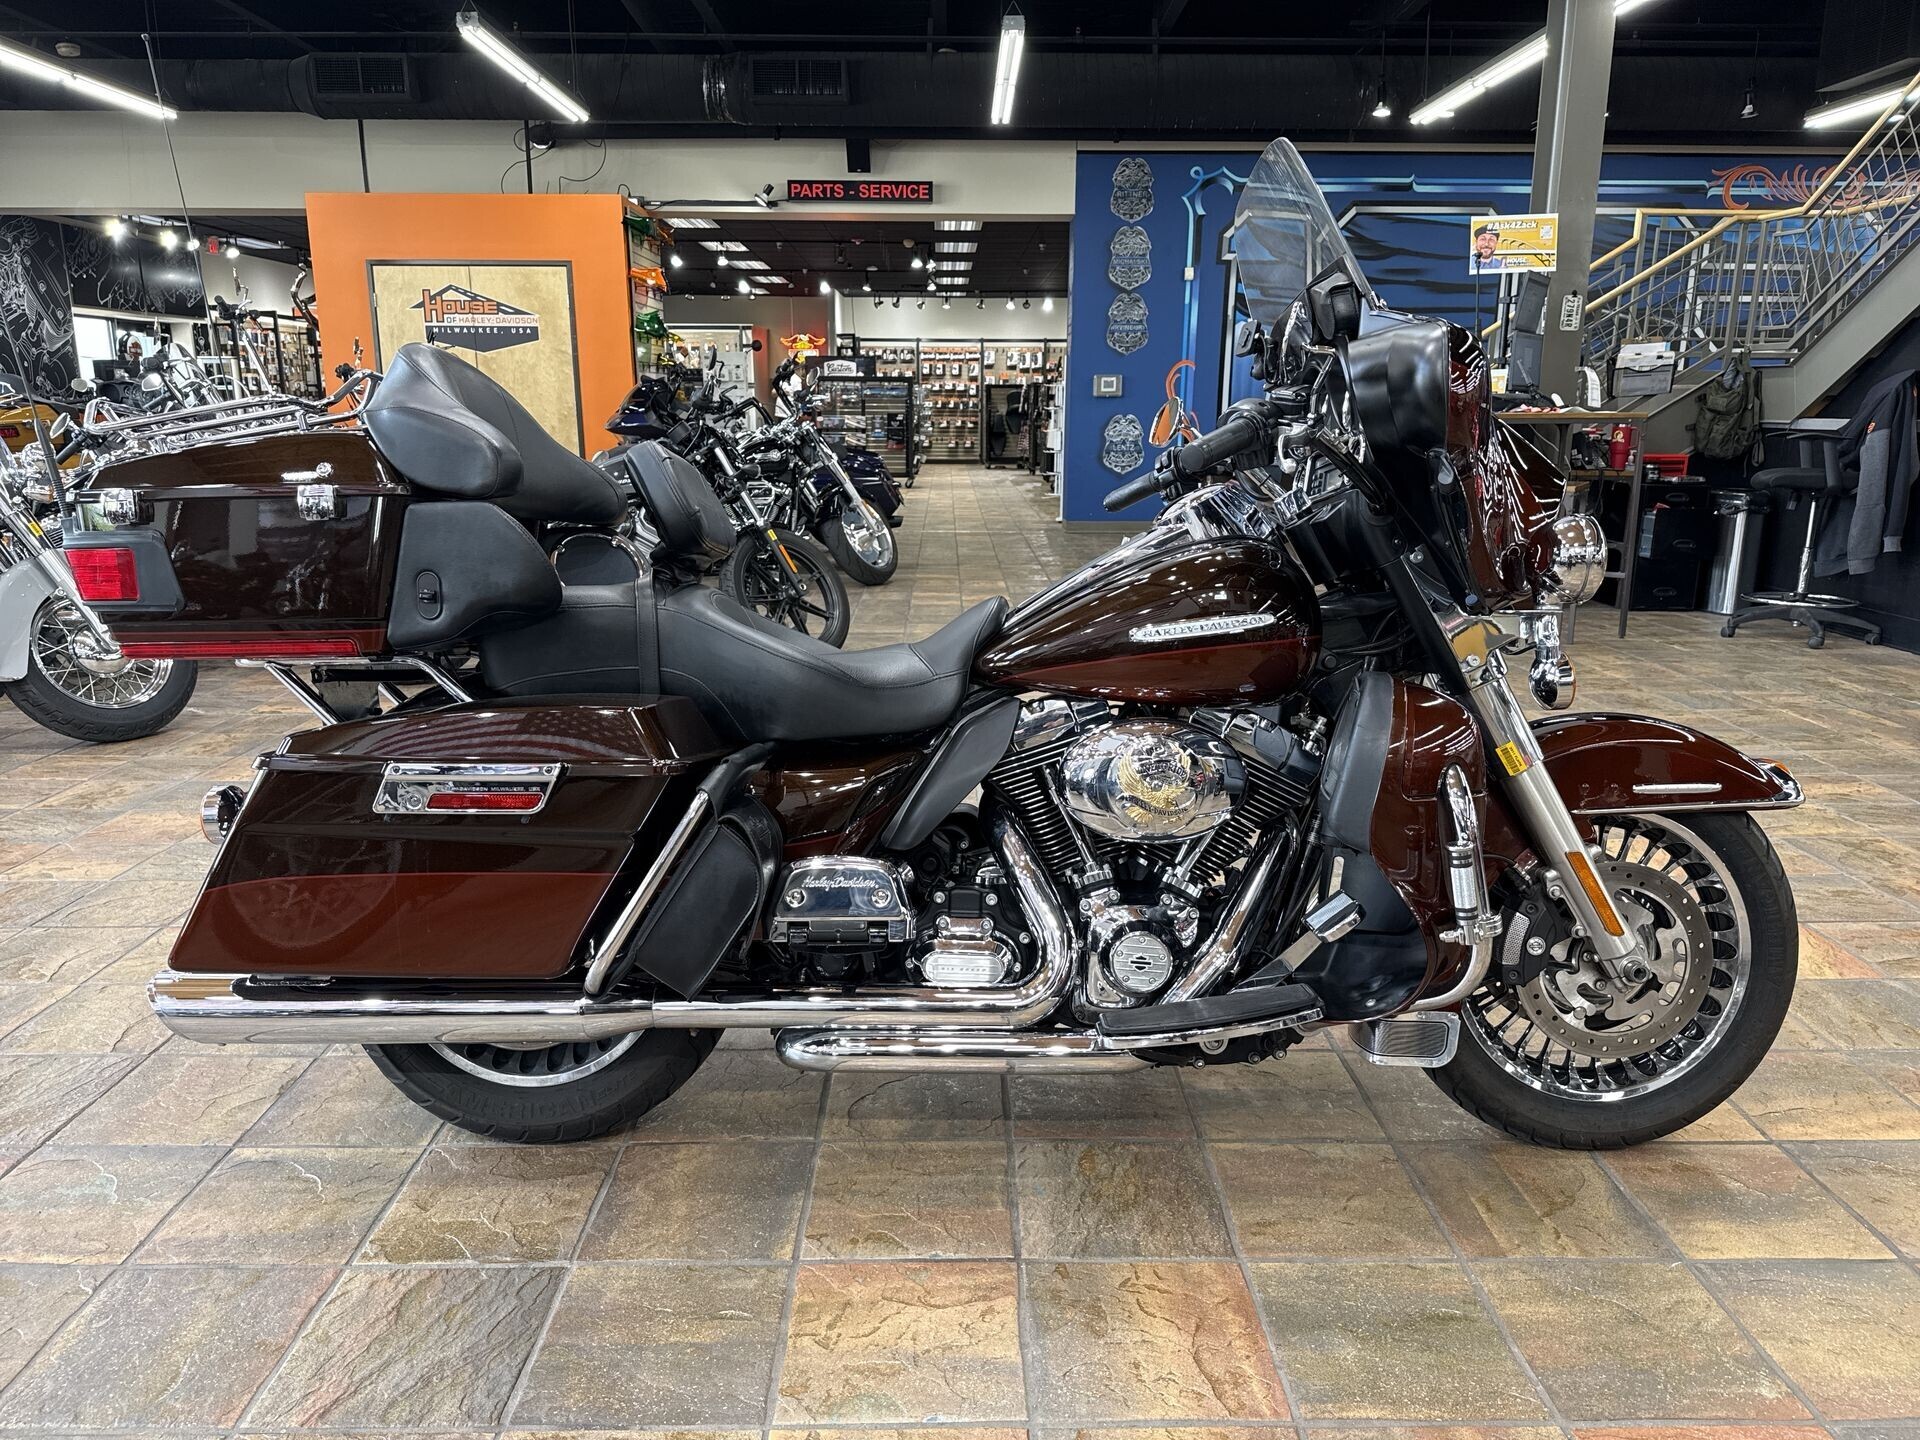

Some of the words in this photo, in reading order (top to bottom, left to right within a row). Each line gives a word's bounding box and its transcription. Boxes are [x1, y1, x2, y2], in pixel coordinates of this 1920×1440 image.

[791, 183, 844, 198] PARTS
[859, 184, 929, 199] SERVICE
[1487, 221, 1537, 230] #Ask4Zack
[422, 289, 499, 323] HOUSE
[446, 316, 457, 324] OF
[459, 316, 538, 324] HARLEY-DAVIDSON
[433, 327, 504, 335] MILWAUKEE,
[1142, 616, 1266, 638] HARLEY-DAVIDSON
